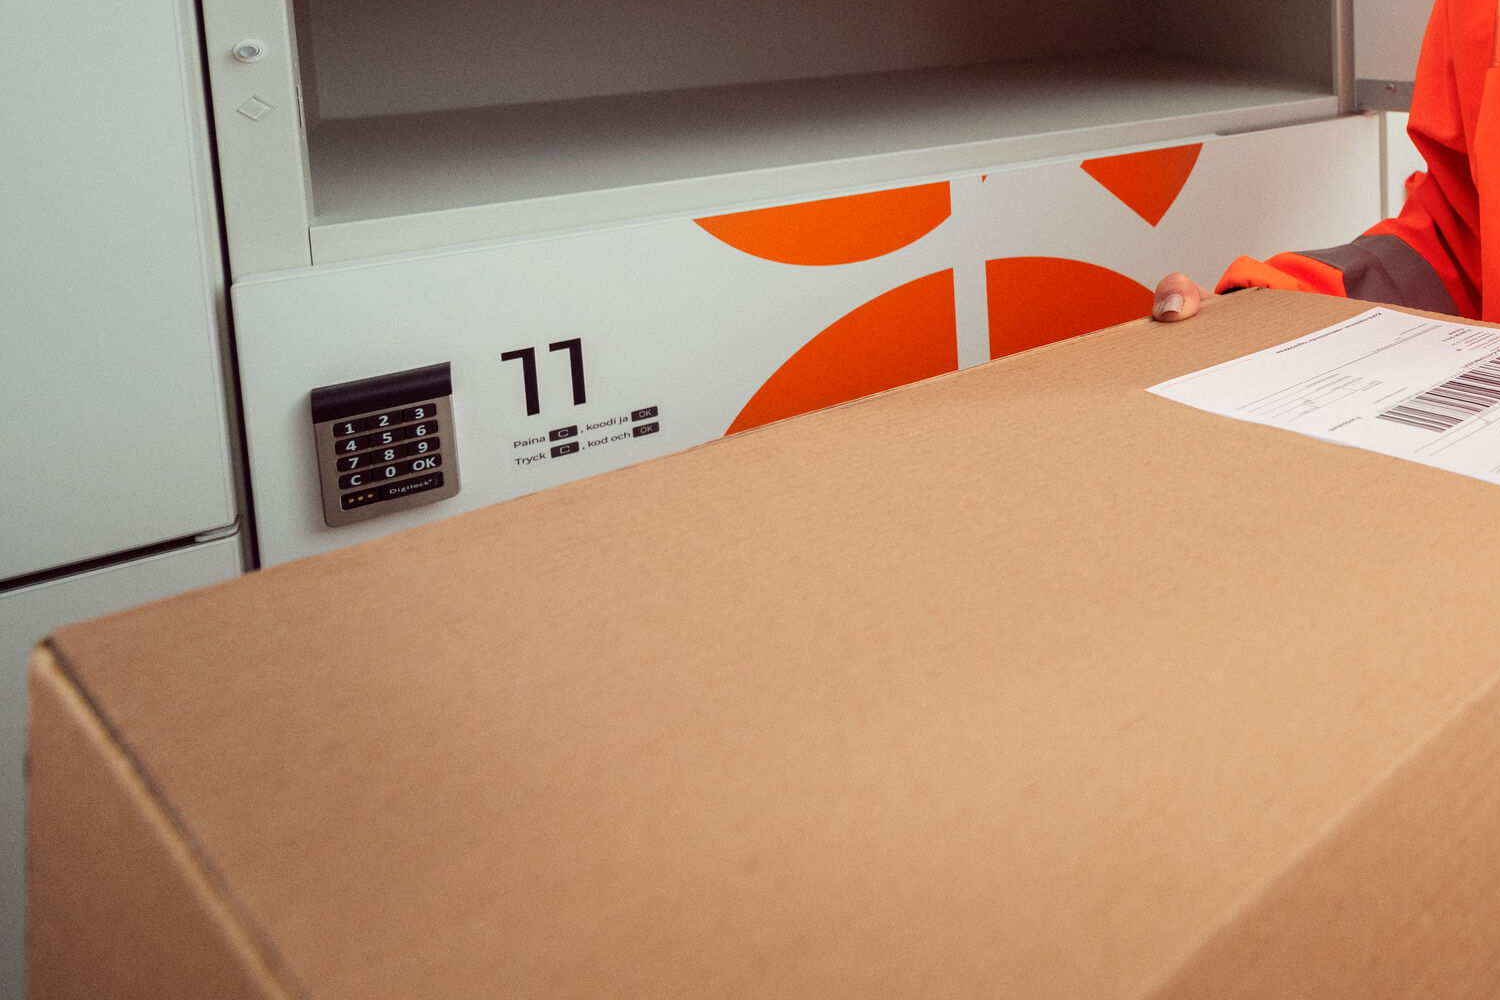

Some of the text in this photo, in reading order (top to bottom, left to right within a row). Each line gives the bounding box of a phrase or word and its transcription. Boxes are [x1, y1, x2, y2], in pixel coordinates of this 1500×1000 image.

[501, 337, 587, 417] 11
[344, 408, 425, 434] 1 2 3
[513, 435, 546, 449] Paina
[558, 429, 569, 438] C
[586, 418, 617, 431] koodi
[618, 415, 628, 425] ja
[638, 409, 651, 418] OK
[345, 424, 427, 451] 4 5 6
[515, 453, 546, 466] Tryck
[559, 445, 571, 454] C
[588, 436, 608, 447] kod
[611, 431, 631, 442] och
[640, 425, 653, 434] OK
[348, 441, 428, 469] 7 8 9
[350, 457, 436, 486] C 0 OK
